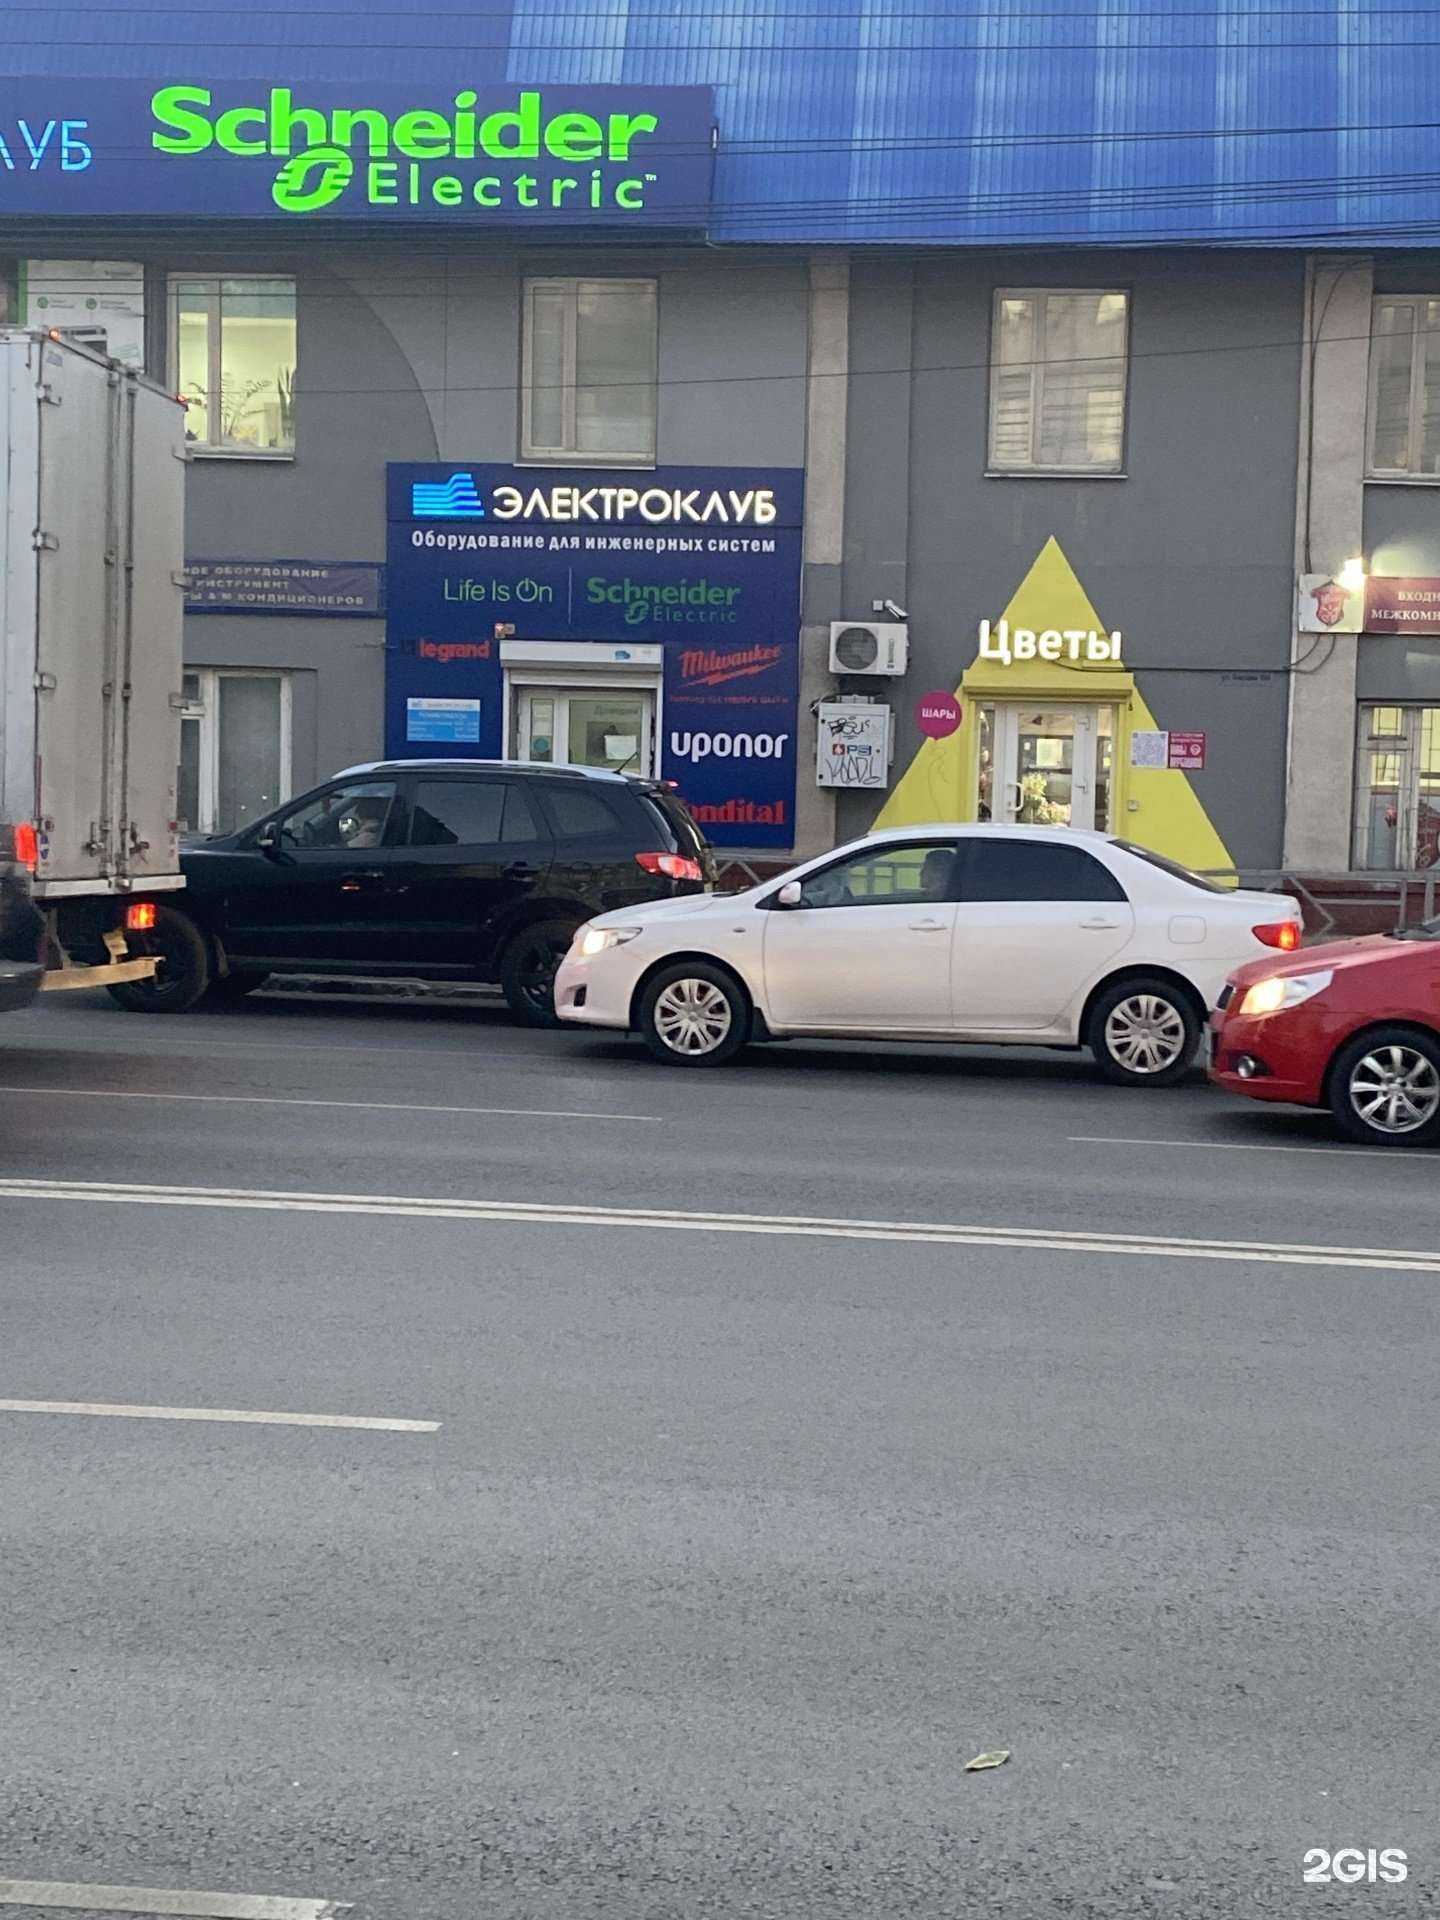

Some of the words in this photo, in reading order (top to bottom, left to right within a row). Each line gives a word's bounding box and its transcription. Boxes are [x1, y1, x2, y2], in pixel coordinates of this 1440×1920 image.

[151, 85, 658, 162] Schneider
[493, 486, 777, 523] ЭЛЕКТРОКЛУБ
[412, 530, 544, 550] Оборудование
[549, 536, 580, 550] для
[585, 536, 703, 553] инженерных
[708, 539, 775, 552] систем
[444, 578, 486, 602] Life
[493, 579, 510, 601] Is
[516, 578, 552, 602] On
[586, 577, 741, 604] Schneider
[654, 605, 738, 624] Electric
[420, 638, 490, 661] legrand
[980, 619, 1122, 666] Цветы
[922, 708, 956, 720] ШАРЫ
[671, 731, 788, 763] uponor
